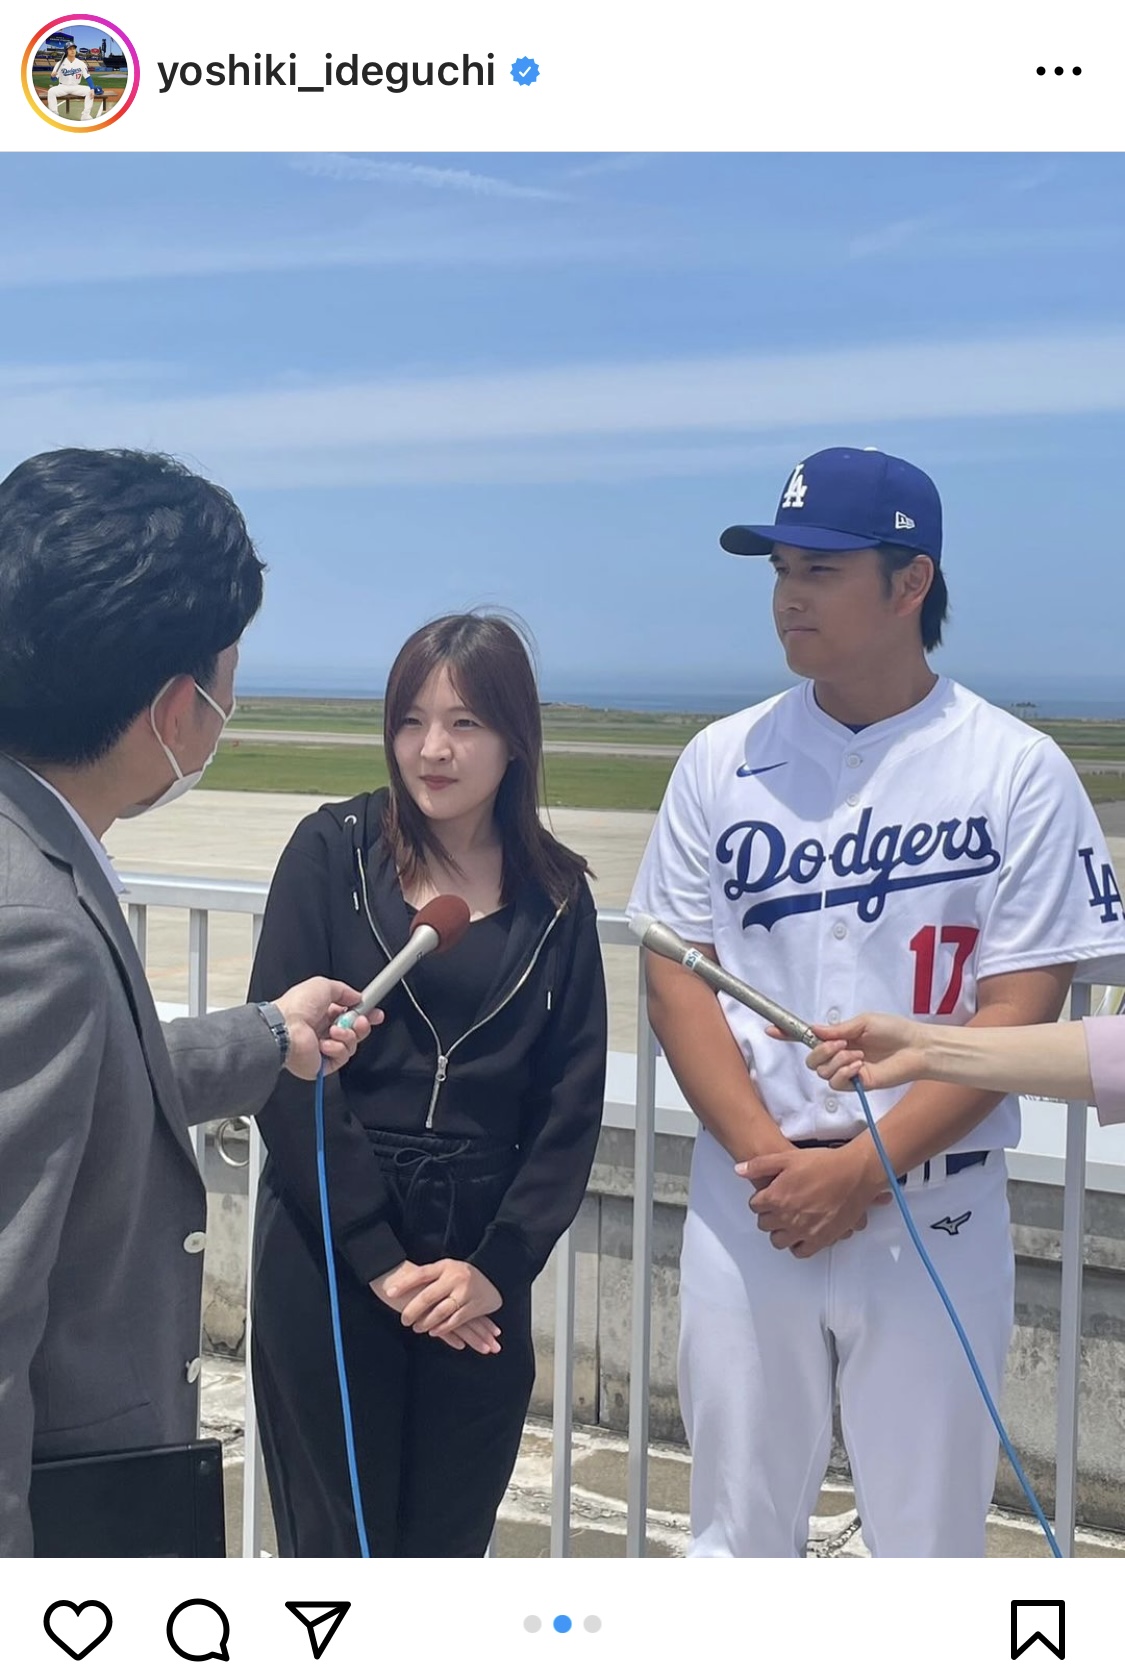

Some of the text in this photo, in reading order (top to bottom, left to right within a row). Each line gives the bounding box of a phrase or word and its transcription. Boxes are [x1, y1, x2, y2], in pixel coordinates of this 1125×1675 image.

[782, 463, 808, 508] LA
[716, 807, 1001, 932] Dodgers
[1078, 847, 1125, 923] LA
[909, 925, 980, 1016] 17
